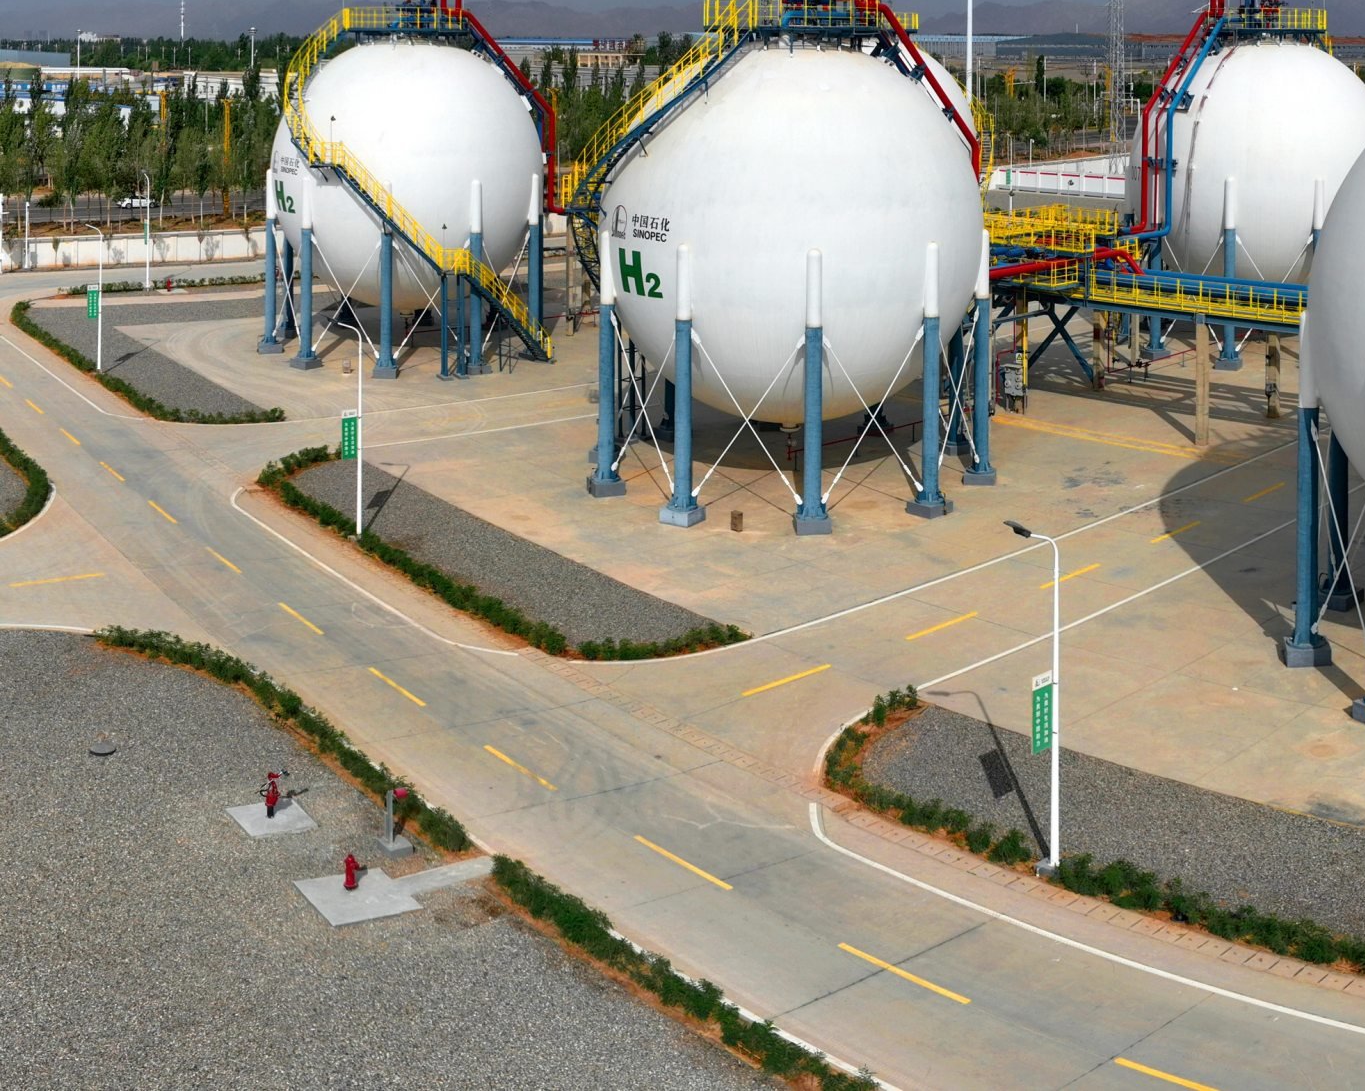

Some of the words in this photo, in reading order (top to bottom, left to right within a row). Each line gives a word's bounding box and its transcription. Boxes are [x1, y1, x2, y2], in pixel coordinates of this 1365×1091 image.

[632, 213, 670, 231] 中国石化
[632, 228, 668, 242] SINOPEC
[618, 247, 664, 299] H2
